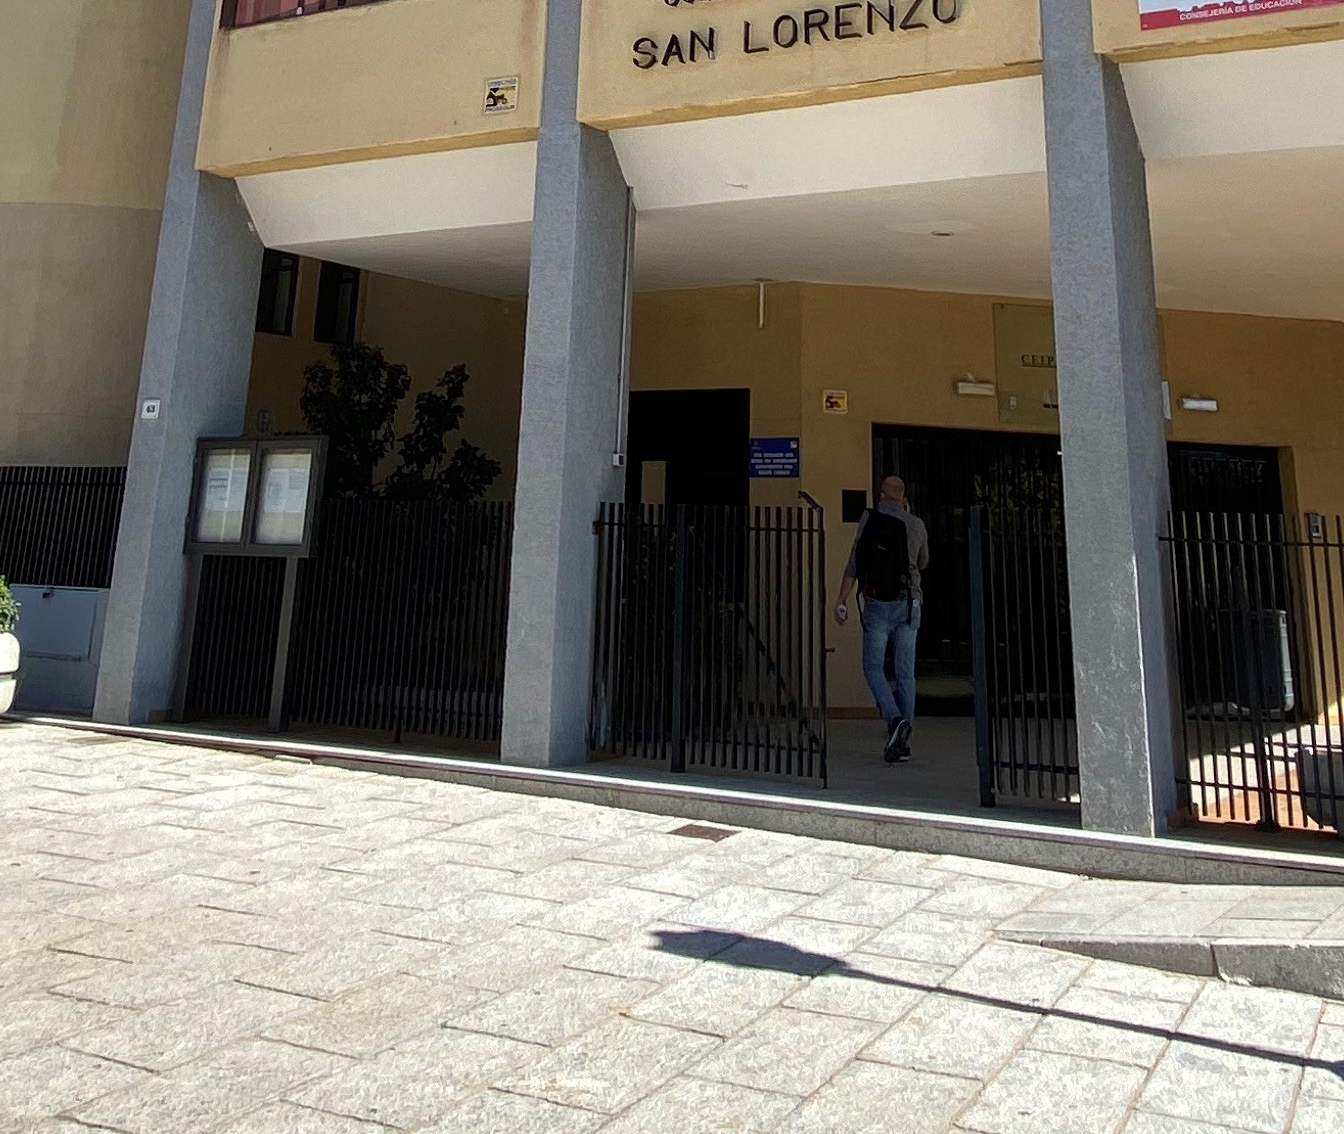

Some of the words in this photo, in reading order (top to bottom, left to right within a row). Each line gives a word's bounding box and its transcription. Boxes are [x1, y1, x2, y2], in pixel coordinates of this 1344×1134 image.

[1179, 5, 1234, 21] CONSEJERÍA
[1235, 3, 1248, 13] DE
[632, 27, 716, 69] SAN
